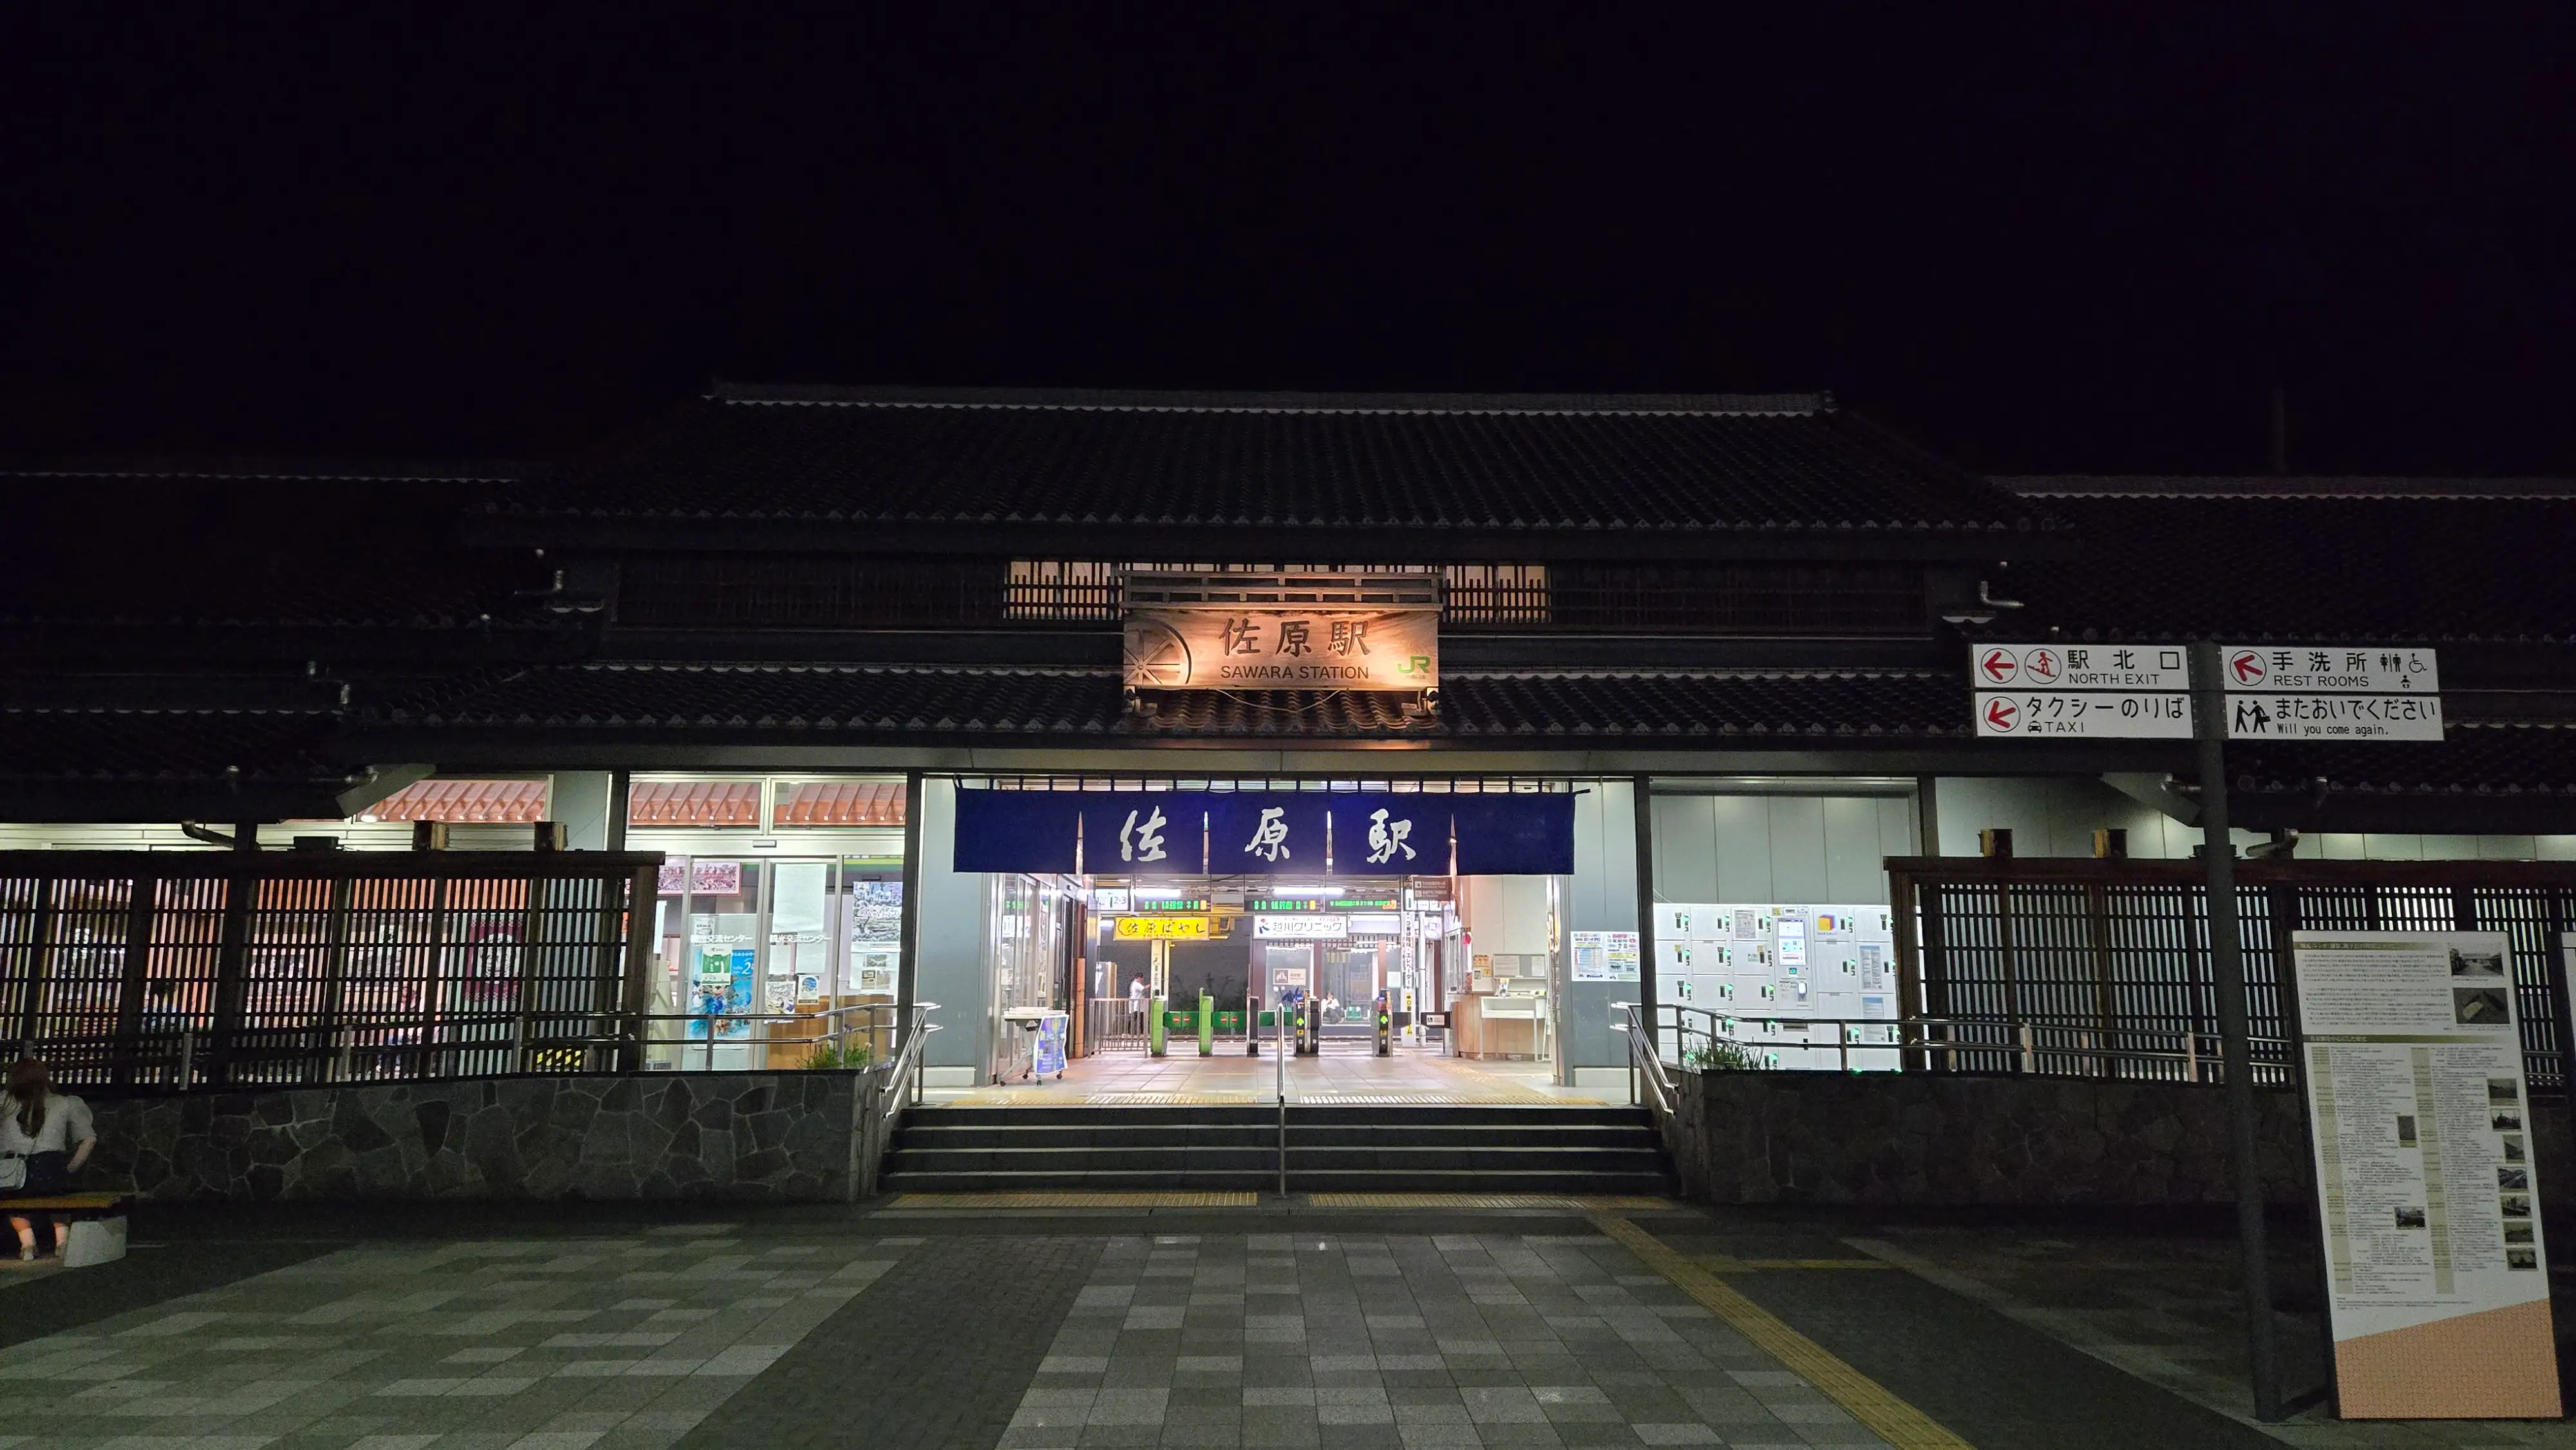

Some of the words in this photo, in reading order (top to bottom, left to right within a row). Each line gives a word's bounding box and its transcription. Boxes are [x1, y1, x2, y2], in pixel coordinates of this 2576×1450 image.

[1218, 616, 1372, 657] 佐原駅
[1397, 655, 1430, 673] JR
[2067, 649, 2180, 670] 駅北口
[2272, 650, 2367, 672] 手洗所
[1220, 664, 1294, 679] SAWARA
[1300, 665, 1370, 679] STATION
[2069, 673, 2119, 684] NORTH
[2126, 674, 2160, 684] EXIT
[2273, 675, 2313, 686] REST
[2318, 675, 2370, 687] ROOMS
[2027, 697, 2185, 719] タクシーのりば
[2275, 699, 2436, 720] またおいでください
[2044, 721, 2085, 733] TAXI
[2277, 724, 2298, 735] Will
[2304, 726, 2322, 737] you
[2327, 726, 2350, 735] come
[2355, 725, 2389, 738] again.
[1120, 805, 1417, 864] 佐原駅
[1126, 921, 1206, 934] 佐原ばやし
[1273, 921, 1341, 932] 越川クリニック
